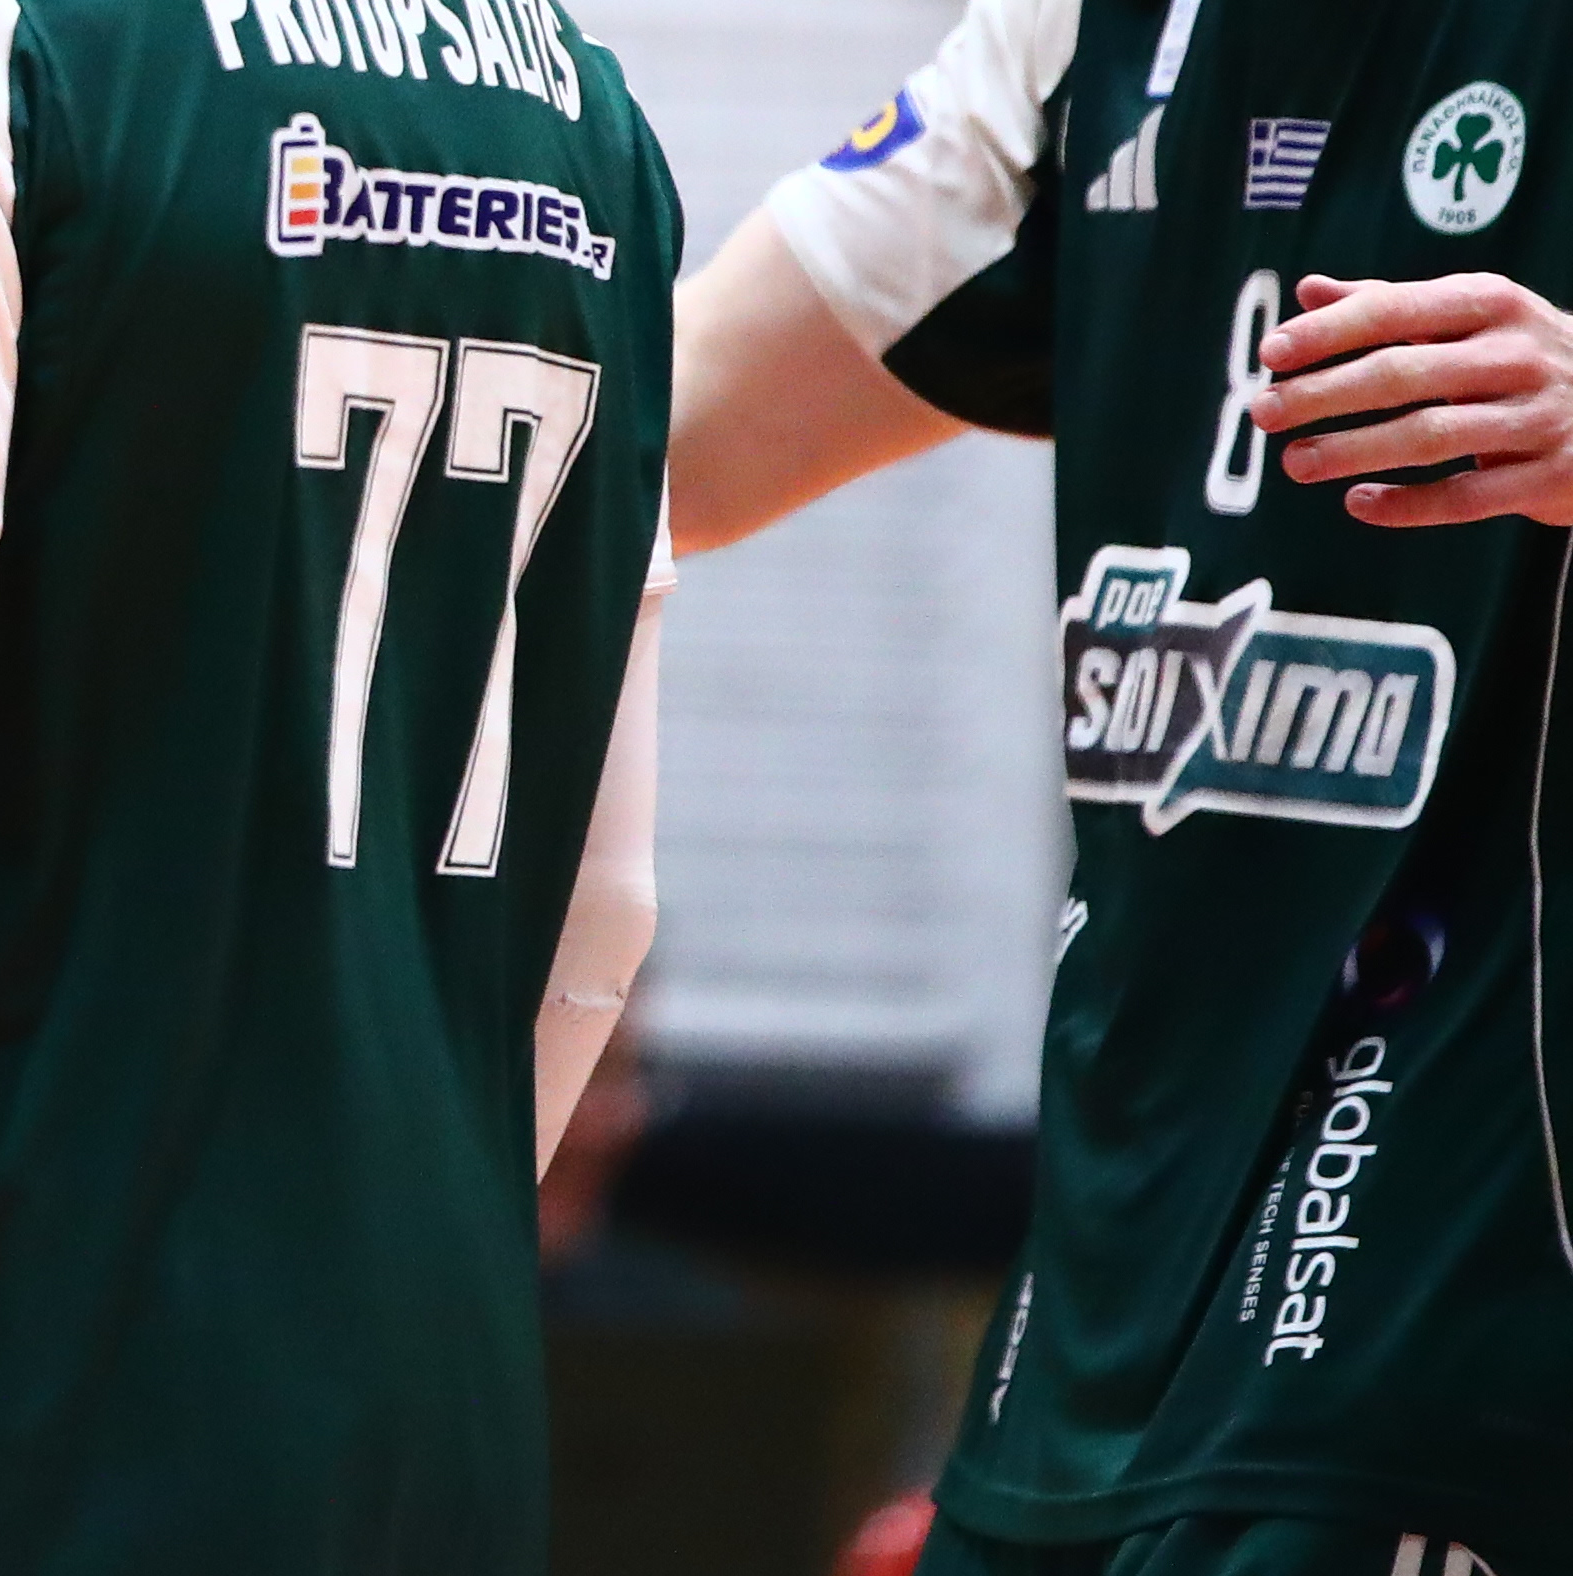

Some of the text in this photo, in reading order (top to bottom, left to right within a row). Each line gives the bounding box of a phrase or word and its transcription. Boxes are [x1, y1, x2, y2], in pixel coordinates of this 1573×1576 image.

[1205, 268, 1281, 515] 8
[295, 321, 603, 878] 77
[1239, 1239, 1271, 1323] SENSES
[1257, 1178, 1287, 1236] TECH
[1262, 1033, 1394, 1368] globalsat
